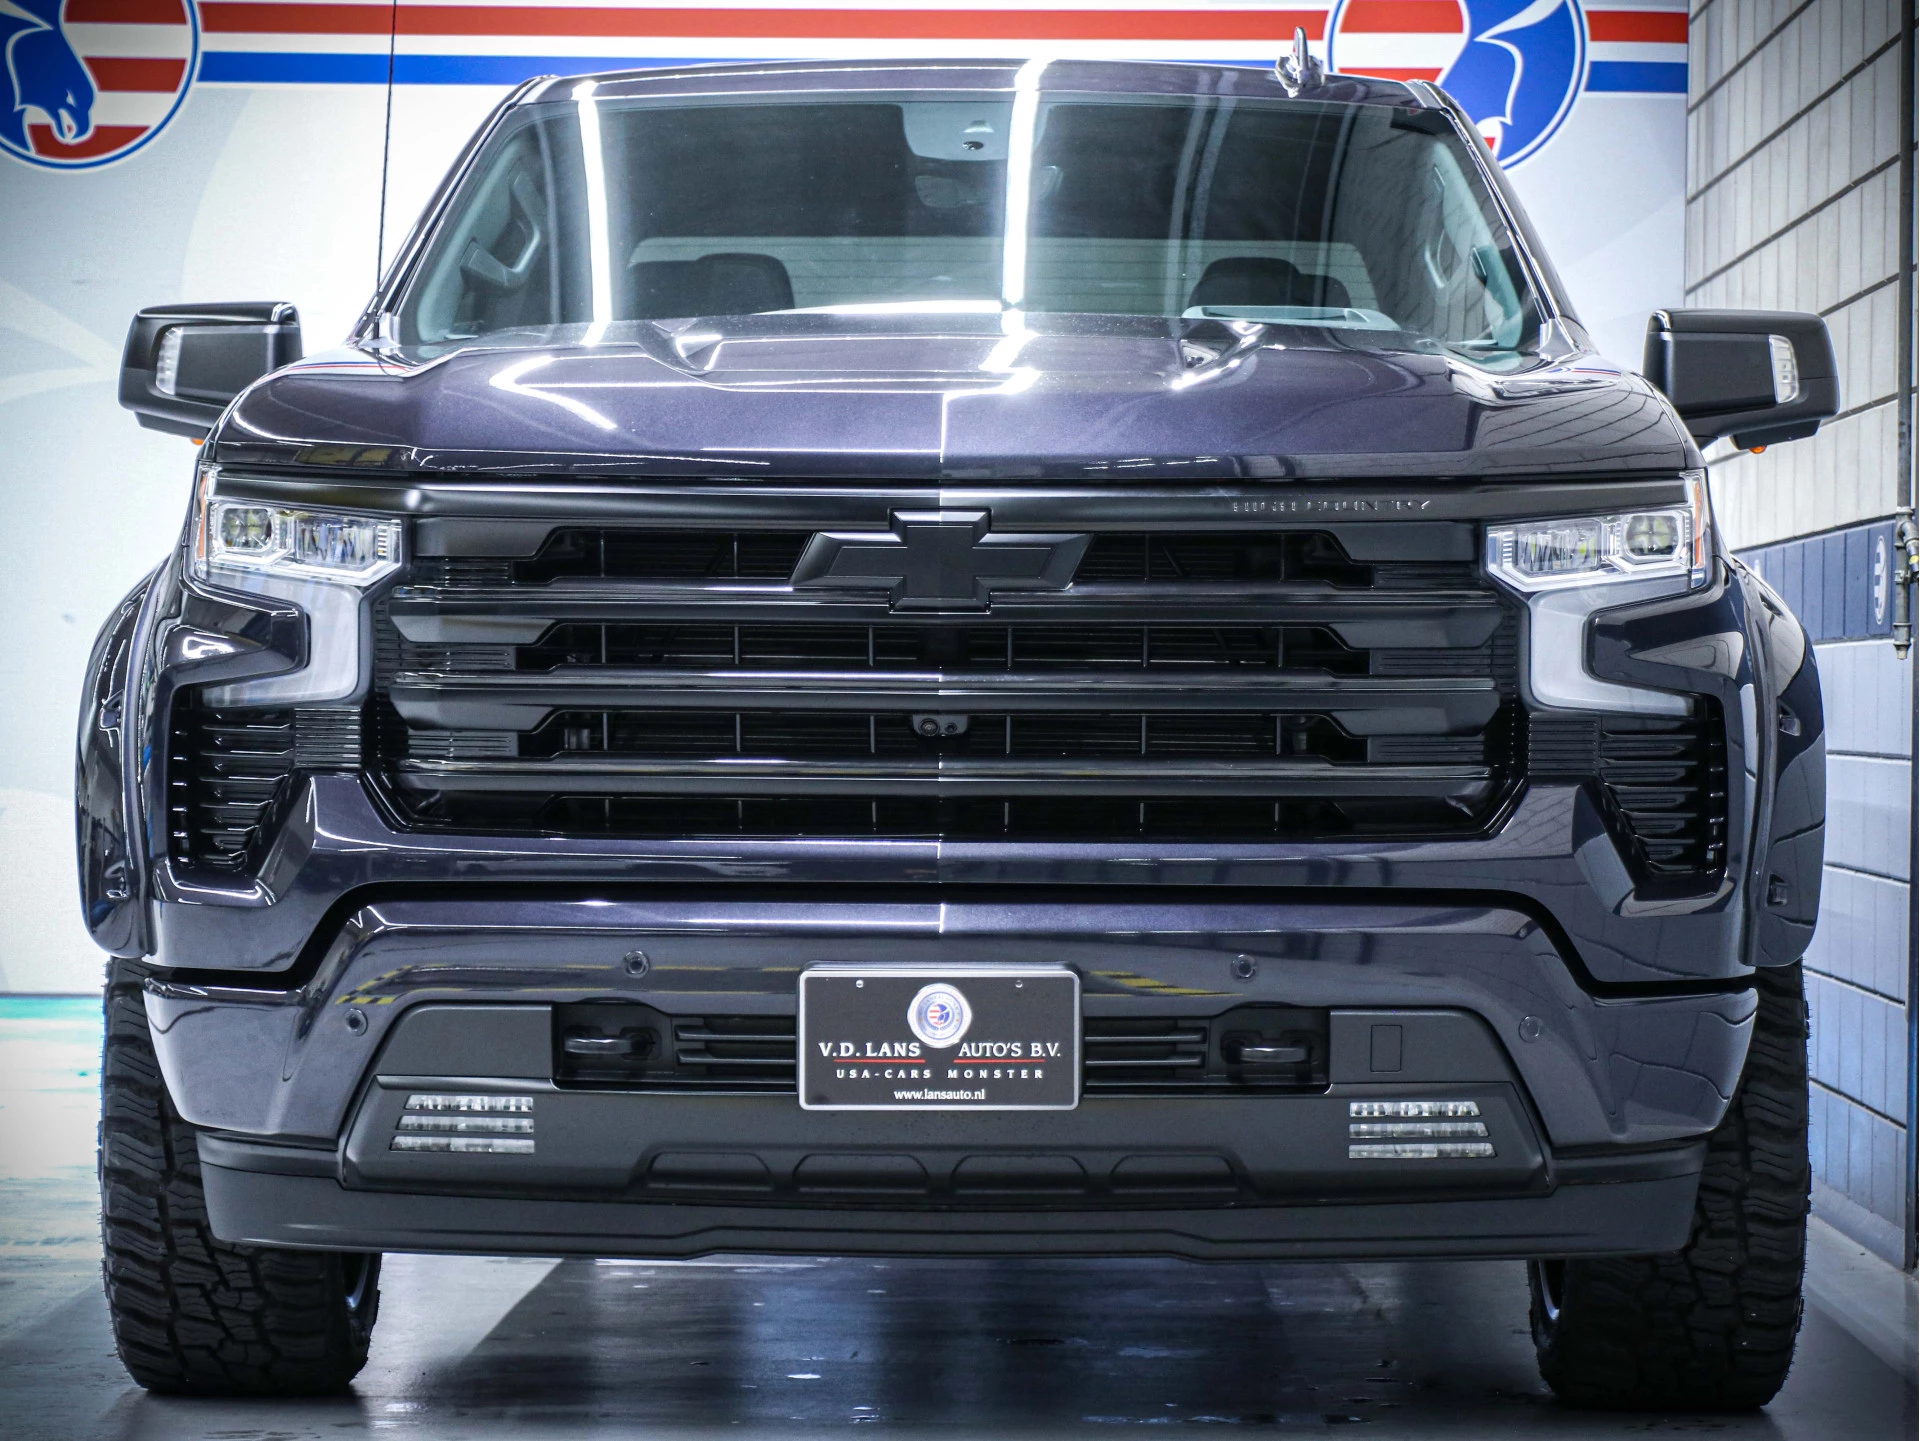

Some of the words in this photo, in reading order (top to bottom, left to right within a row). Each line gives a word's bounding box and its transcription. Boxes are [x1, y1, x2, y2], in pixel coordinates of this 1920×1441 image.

[818, 1042, 860, 1057] V.D.
[865, 1042, 921, 1057] LANS
[958, 1042, 1022, 1057] AUTO'S
[1030, 1042, 1061, 1057] B.V.
[836, 1069, 932, 1079] USA-CARS
[947, 1069, 1043, 1079] MONSTER
[893, 1088, 985, 1100] www.lansauto.nl
